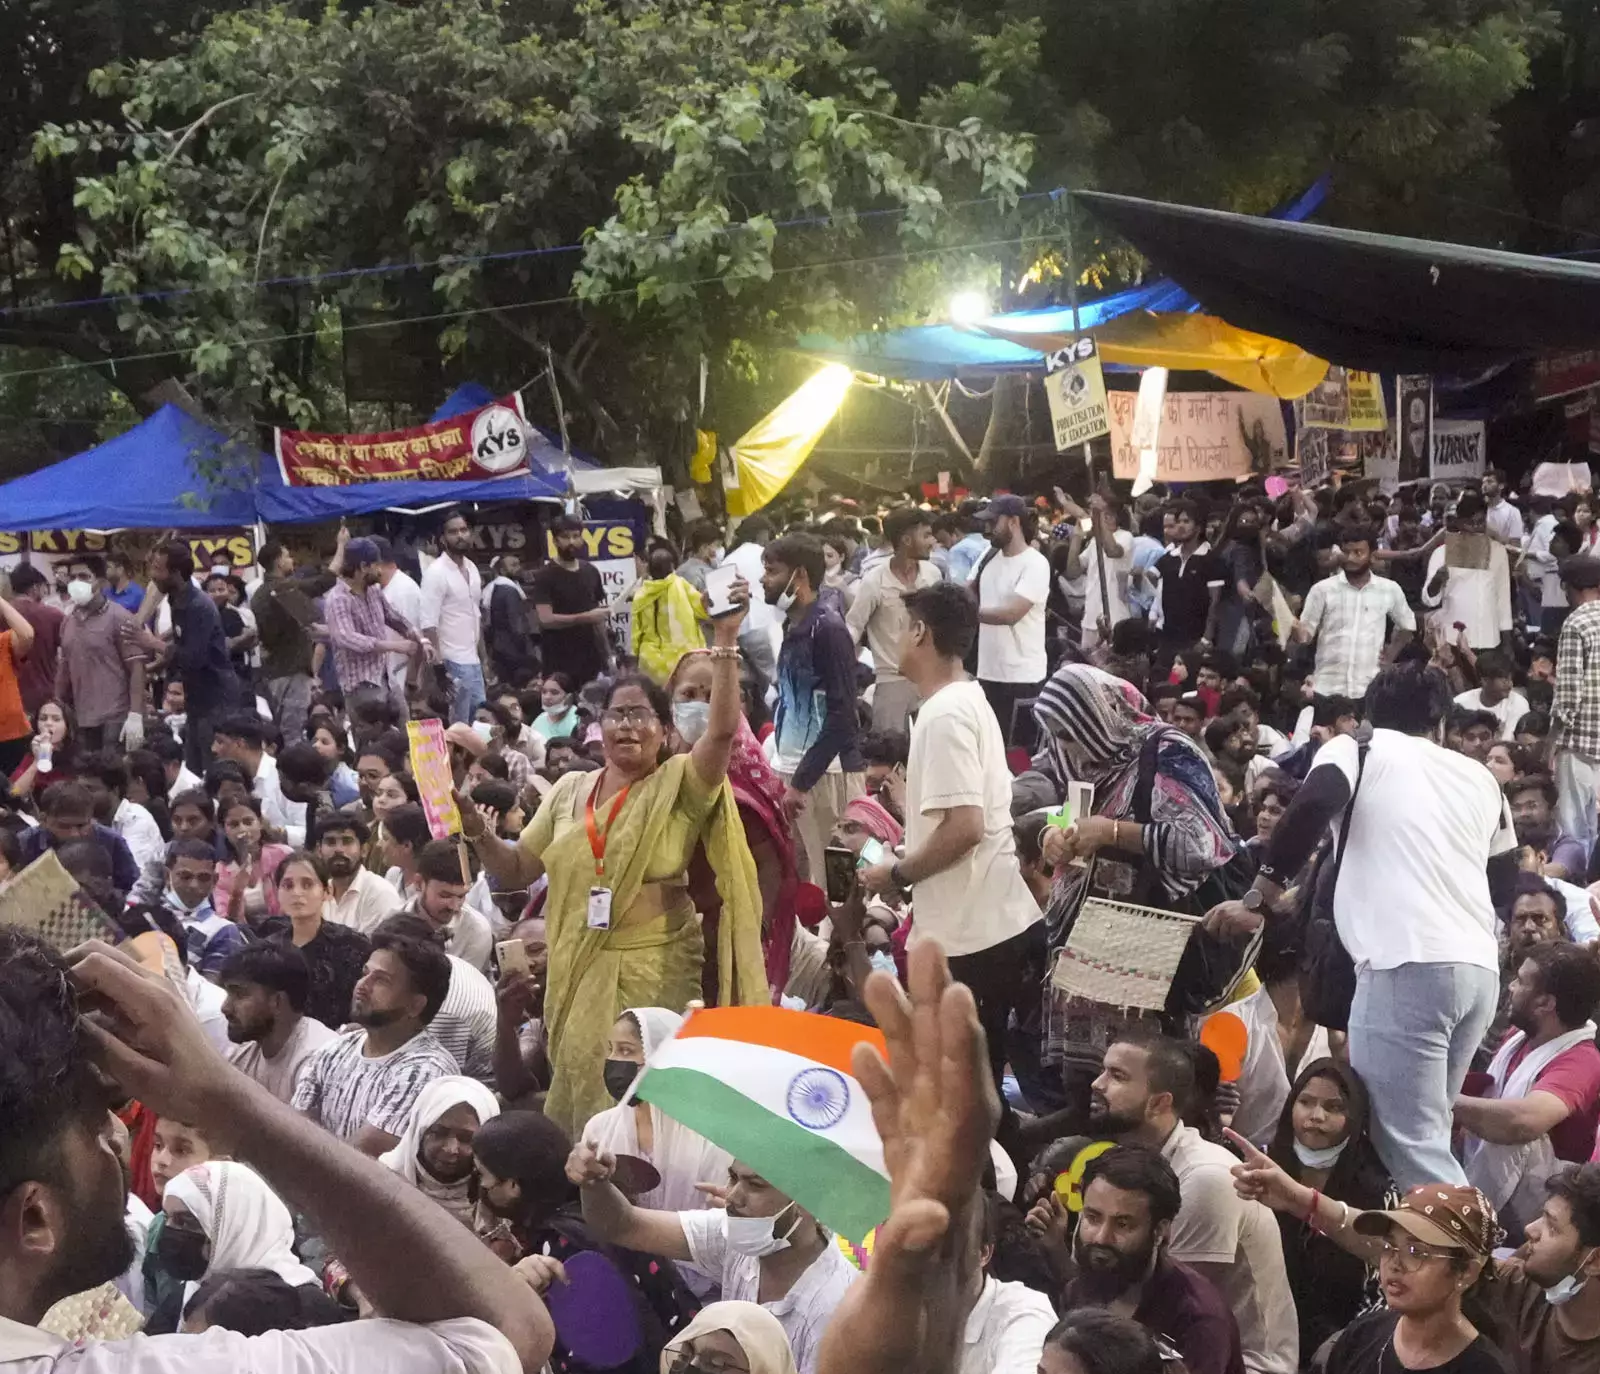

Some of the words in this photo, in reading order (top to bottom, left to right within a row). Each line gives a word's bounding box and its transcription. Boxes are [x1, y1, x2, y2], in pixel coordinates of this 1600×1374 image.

[1045, 338, 1093, 373] KYS
[1068, 417, 1107, 441] EDUCATION
[477, 428, 521, 458] KYS
[31, 530, 106, 551] KYS
